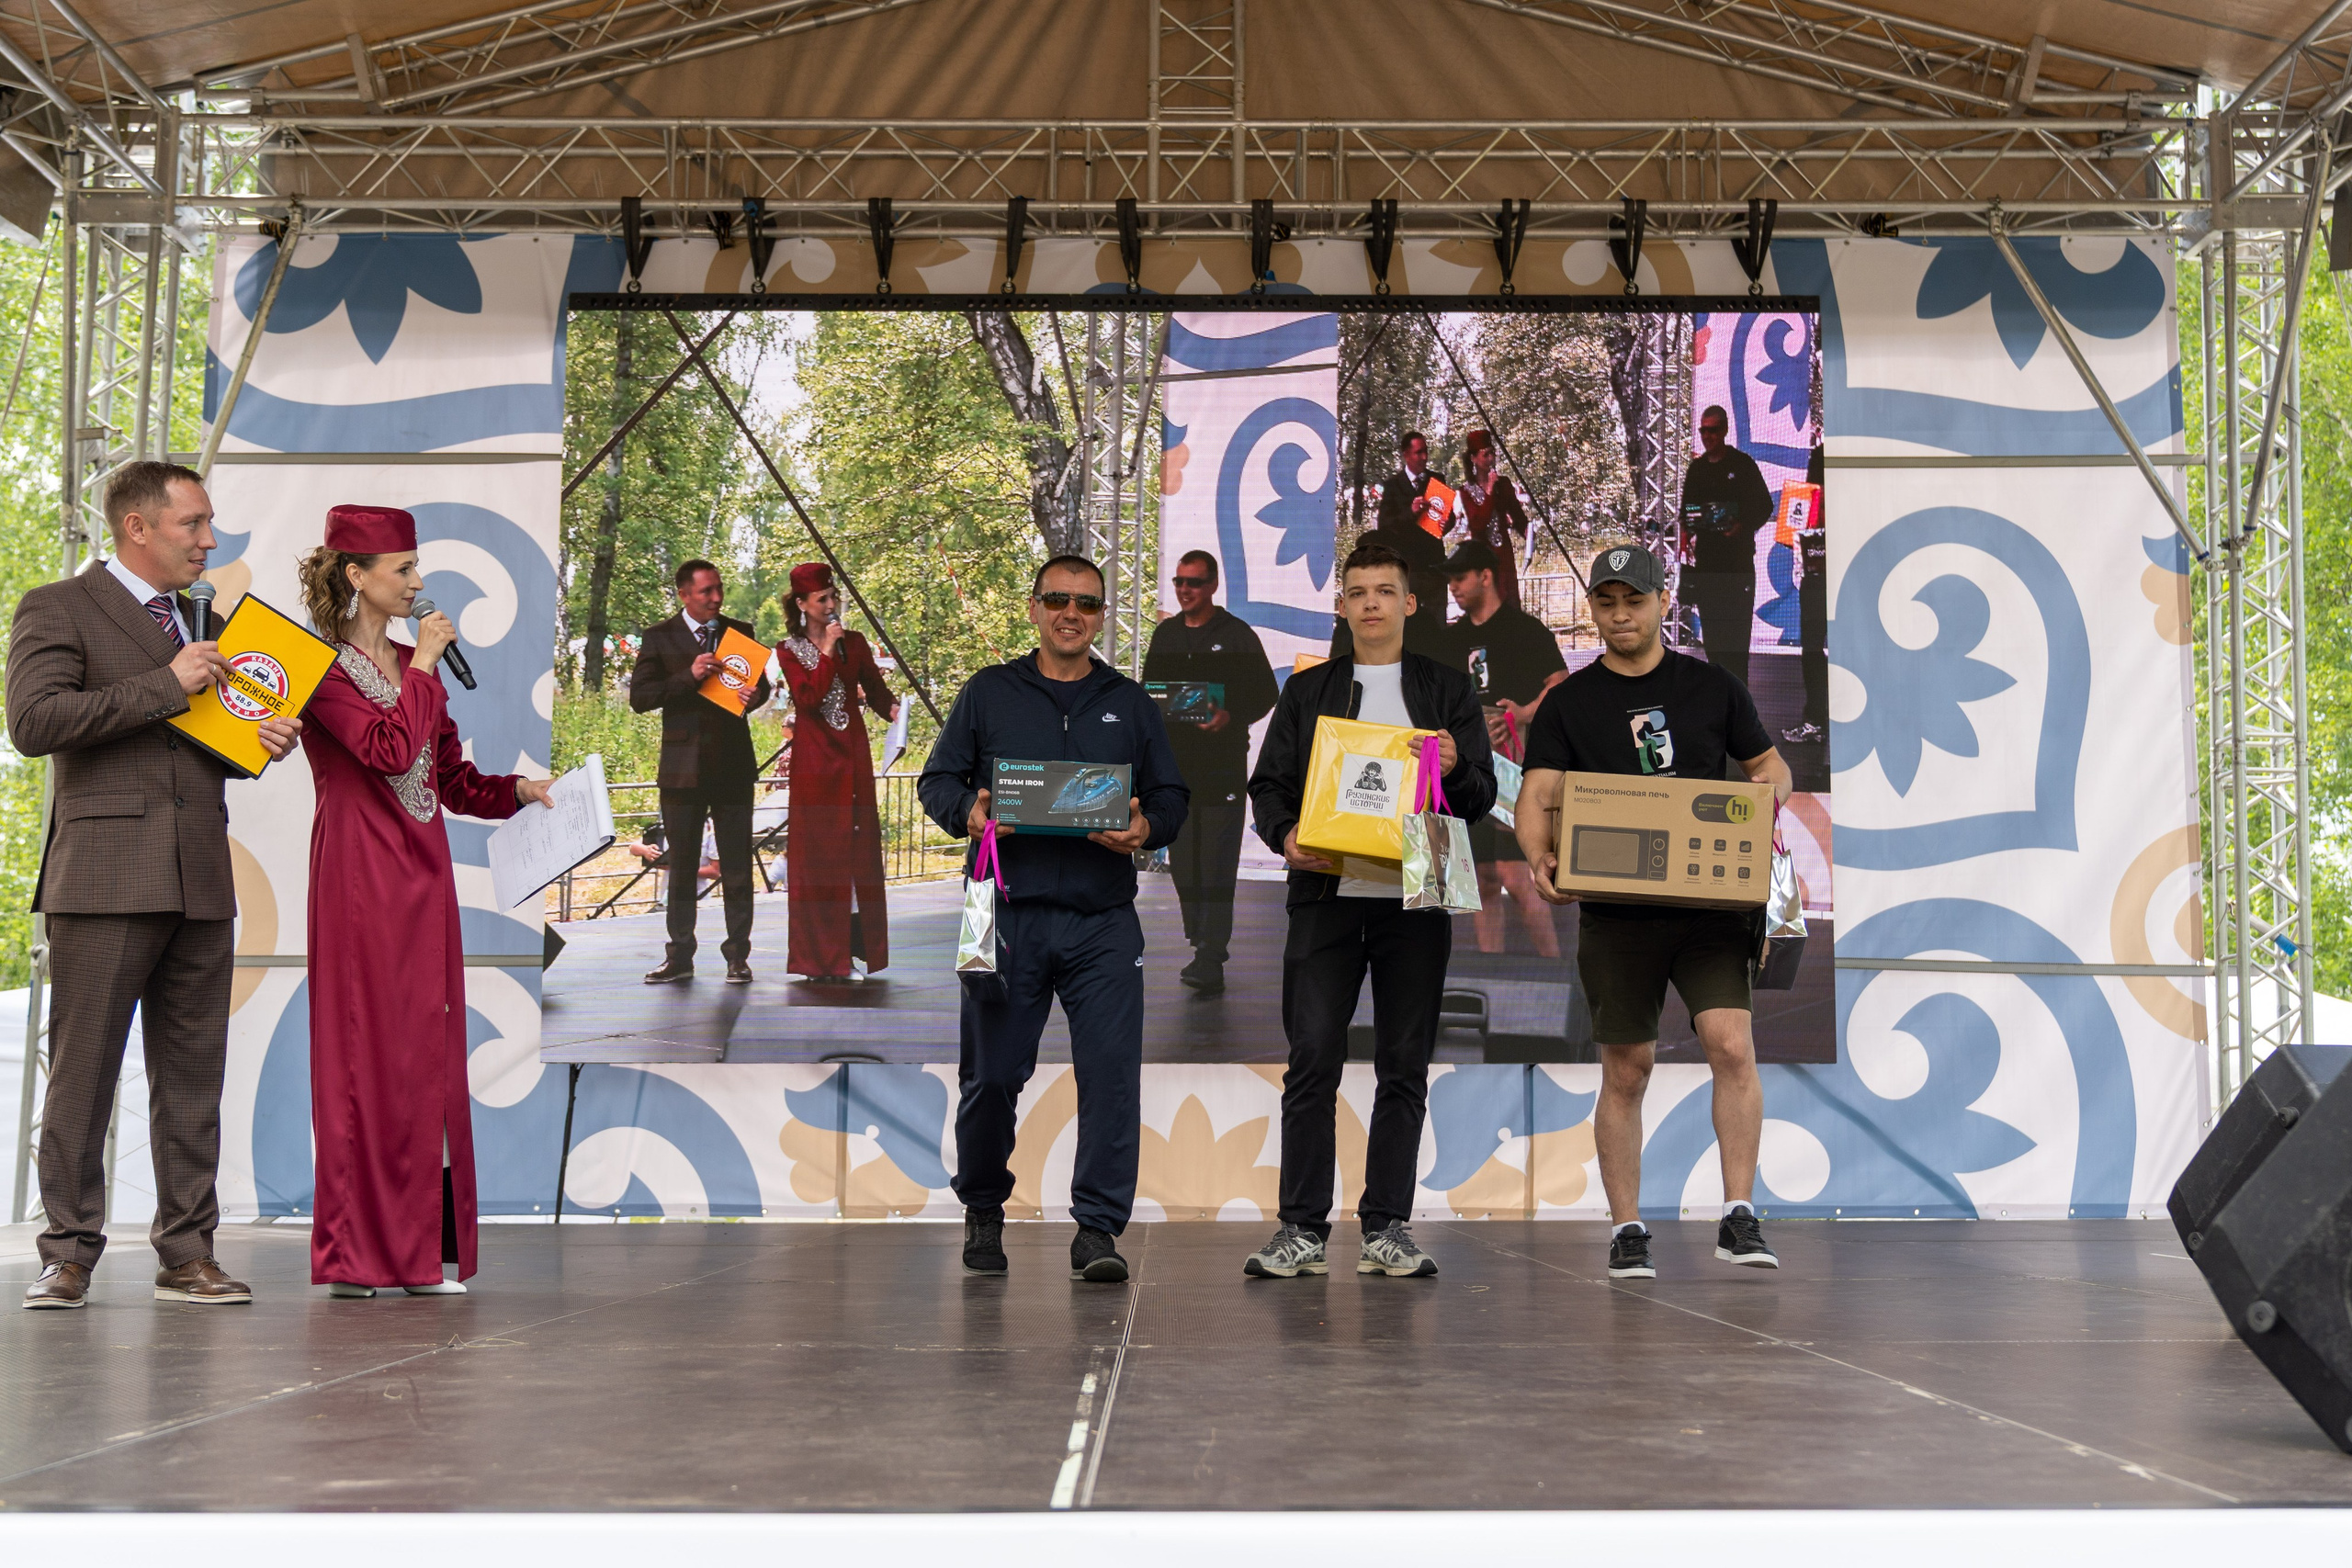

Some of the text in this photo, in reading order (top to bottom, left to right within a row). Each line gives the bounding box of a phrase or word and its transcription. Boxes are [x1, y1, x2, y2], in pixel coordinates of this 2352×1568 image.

[251, 655, 282, 678] КАЗАНЬ
[223, 671, 285, 712] ОРОЖНОЕ
[235, 694, 252, 707] 88.9
[223, 693, 260, 716] РАДИО
[998, 778, 1044, 787] STEAM IRON
[1574, 784, 1669, 799] Микроволновая печь
